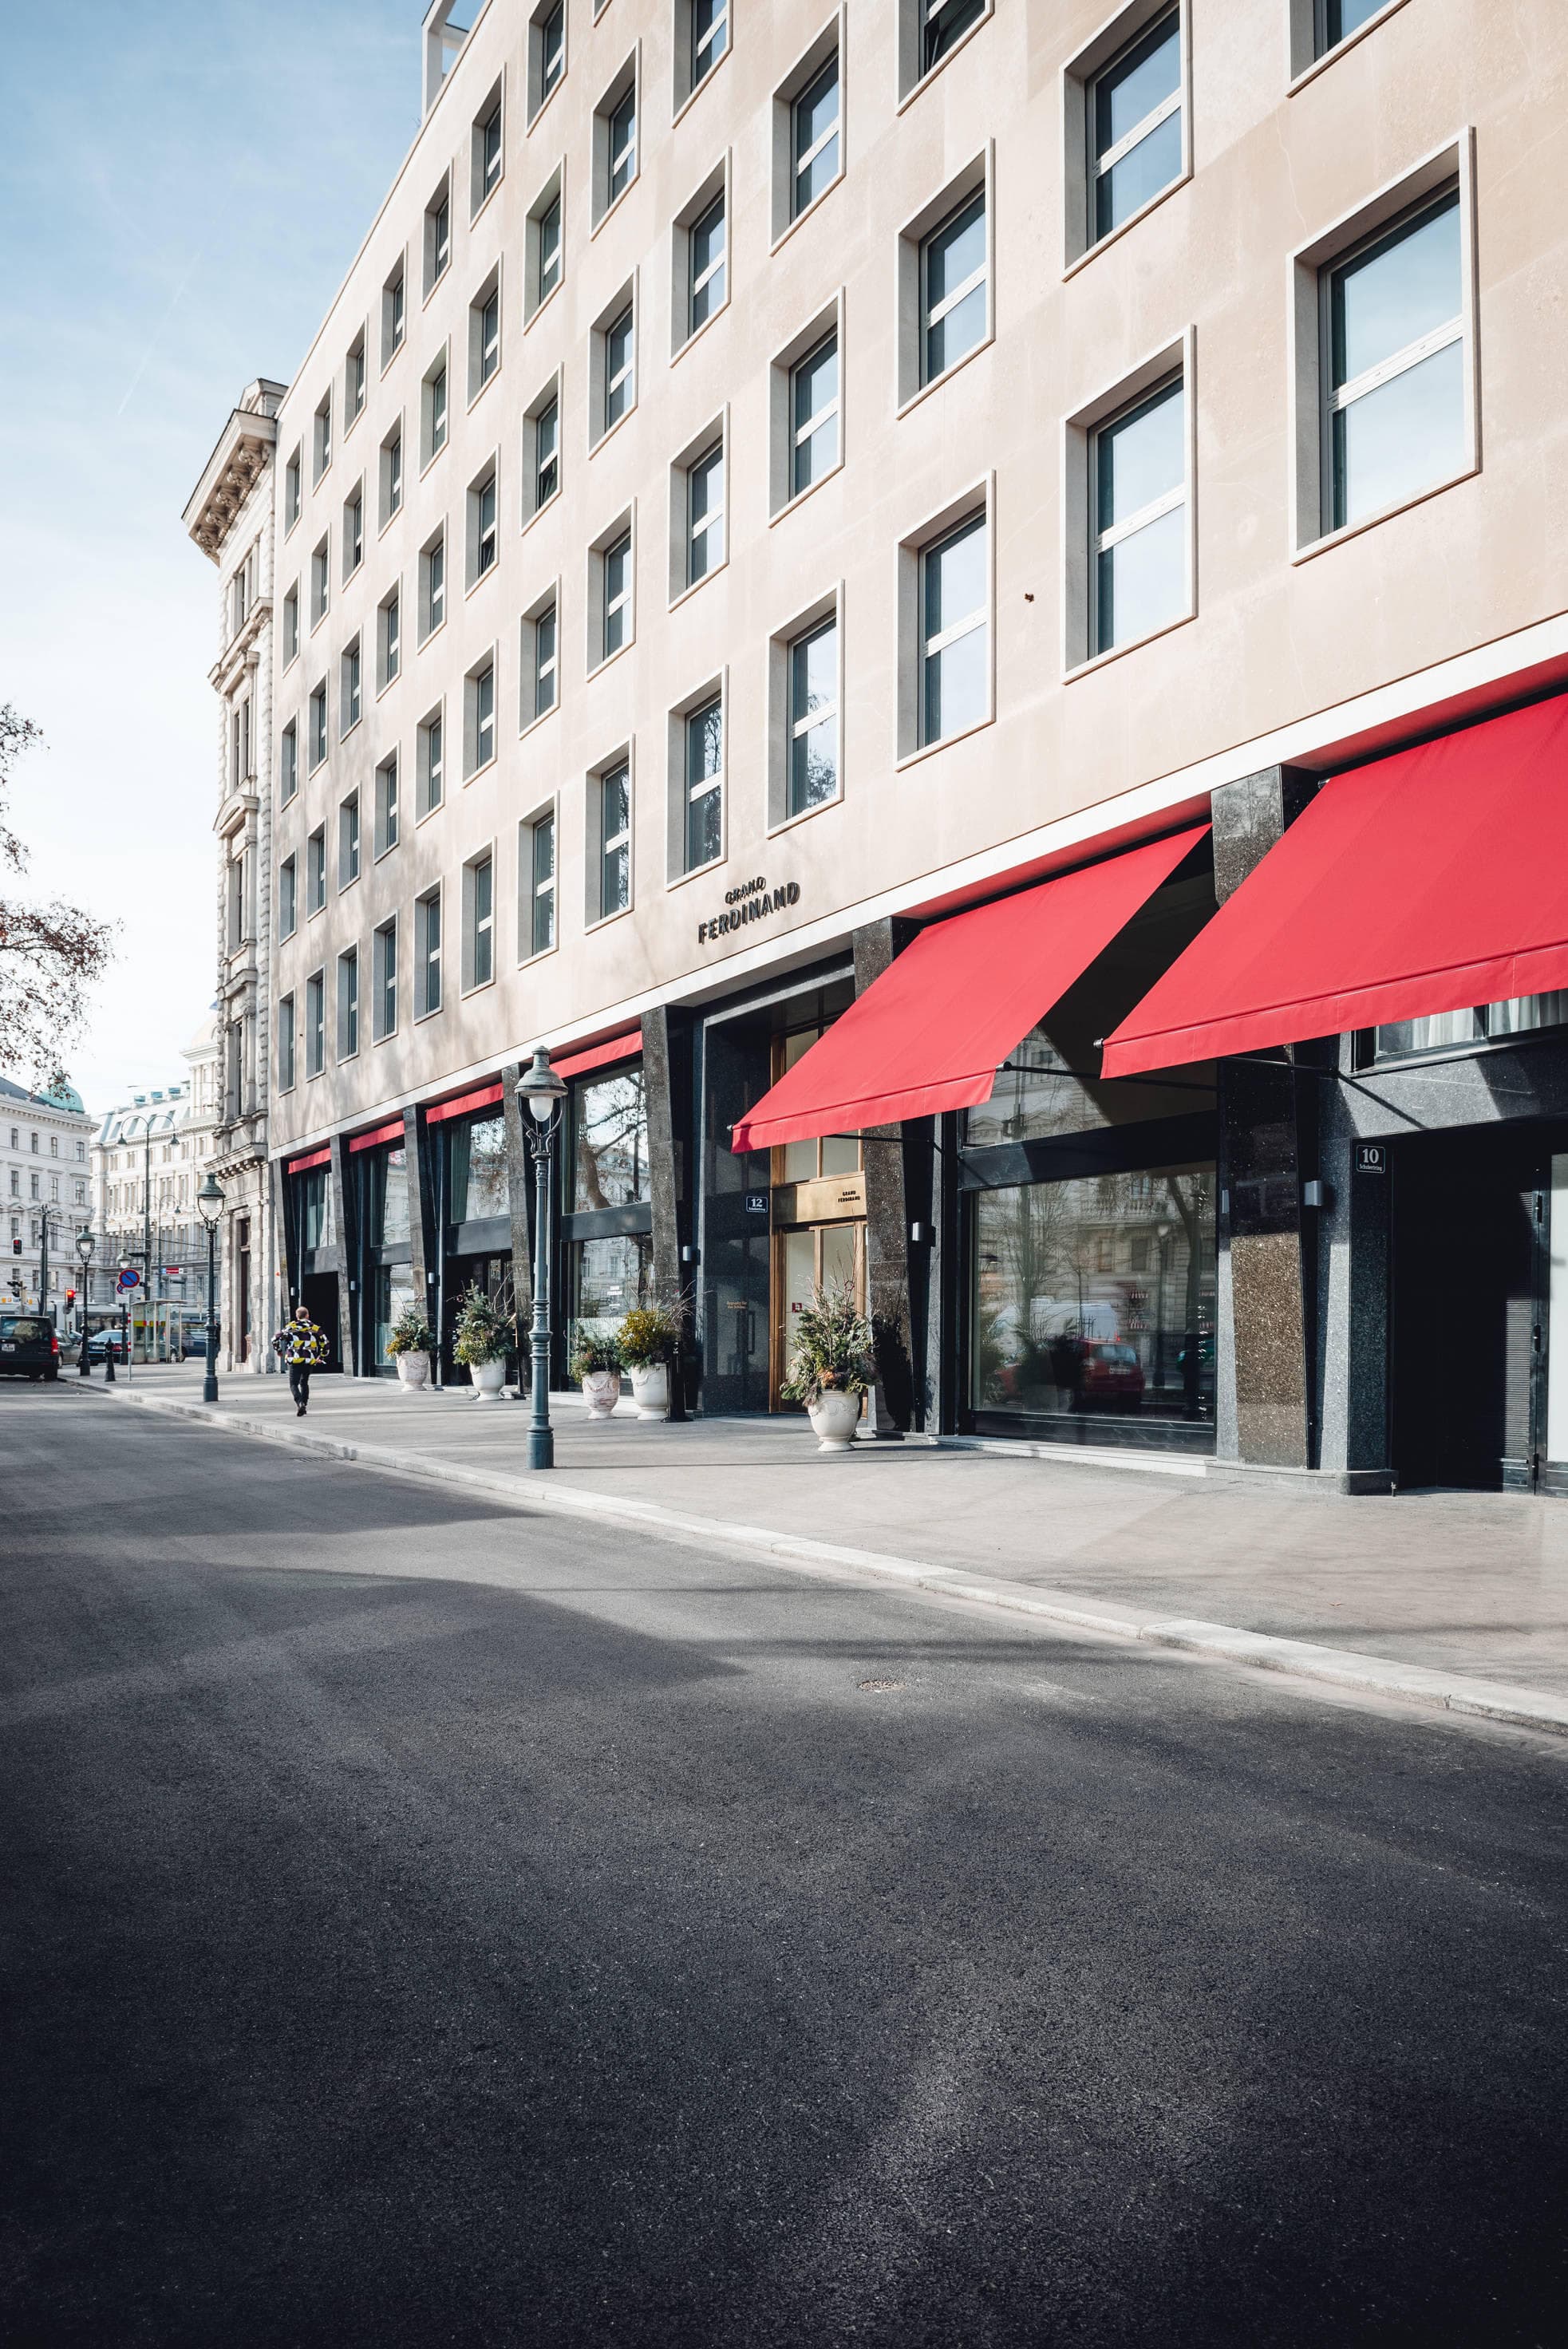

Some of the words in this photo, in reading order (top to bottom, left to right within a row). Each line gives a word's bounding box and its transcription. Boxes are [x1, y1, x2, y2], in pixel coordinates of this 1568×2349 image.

[725, 876, 767, 906] GRAND
[697, 882, 800, 945] FERDINAND
[1362, 1148, 1379, 1163] 10
[751, 1198, 763, 1207] 12
